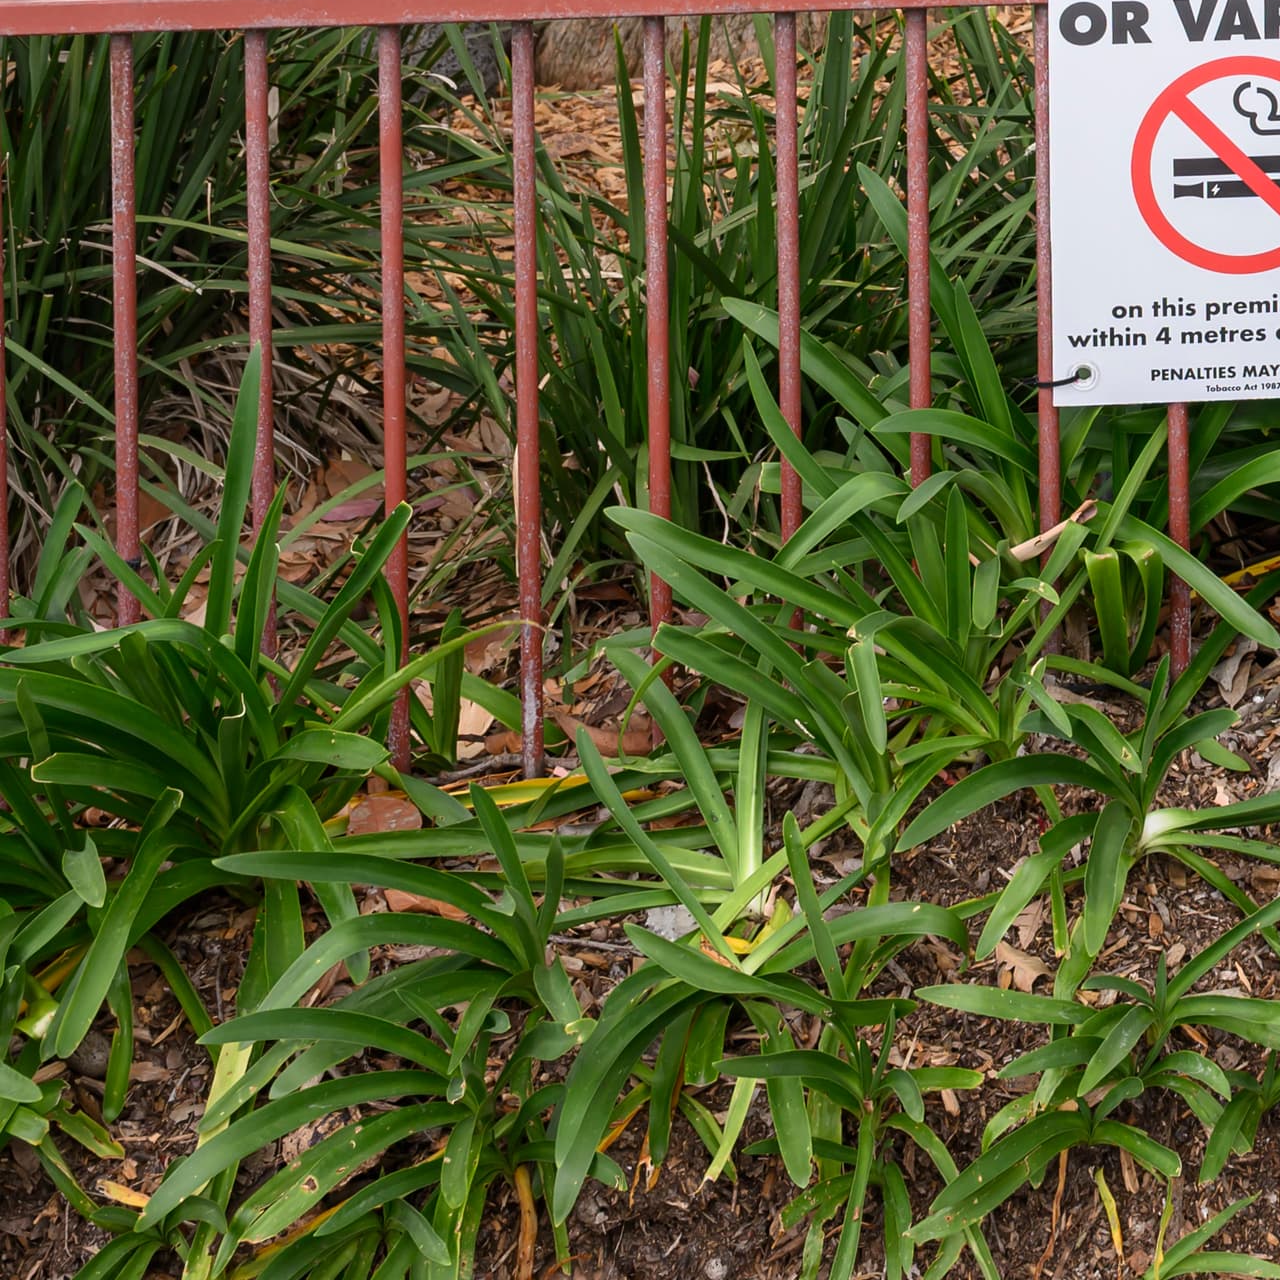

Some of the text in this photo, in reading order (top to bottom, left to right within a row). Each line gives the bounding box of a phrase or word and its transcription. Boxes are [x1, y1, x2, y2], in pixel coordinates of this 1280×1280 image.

[1058, 0, 1153, 47] OR
[1111, 303, 1143, 320] on
[1151, 296, 1197, 318] this
[1066, 326, 1147, 349] within
[1155, 326, 1173, 345] 4
[1180, 323, 1267, 345] metres
[1150, 365, 1237, 382] PENALTIES
[1241, 363, 1280, 379] MAY
[1205, 383, 1242, 393] Tobacco
[1243, 382, 1258, 391] Act
